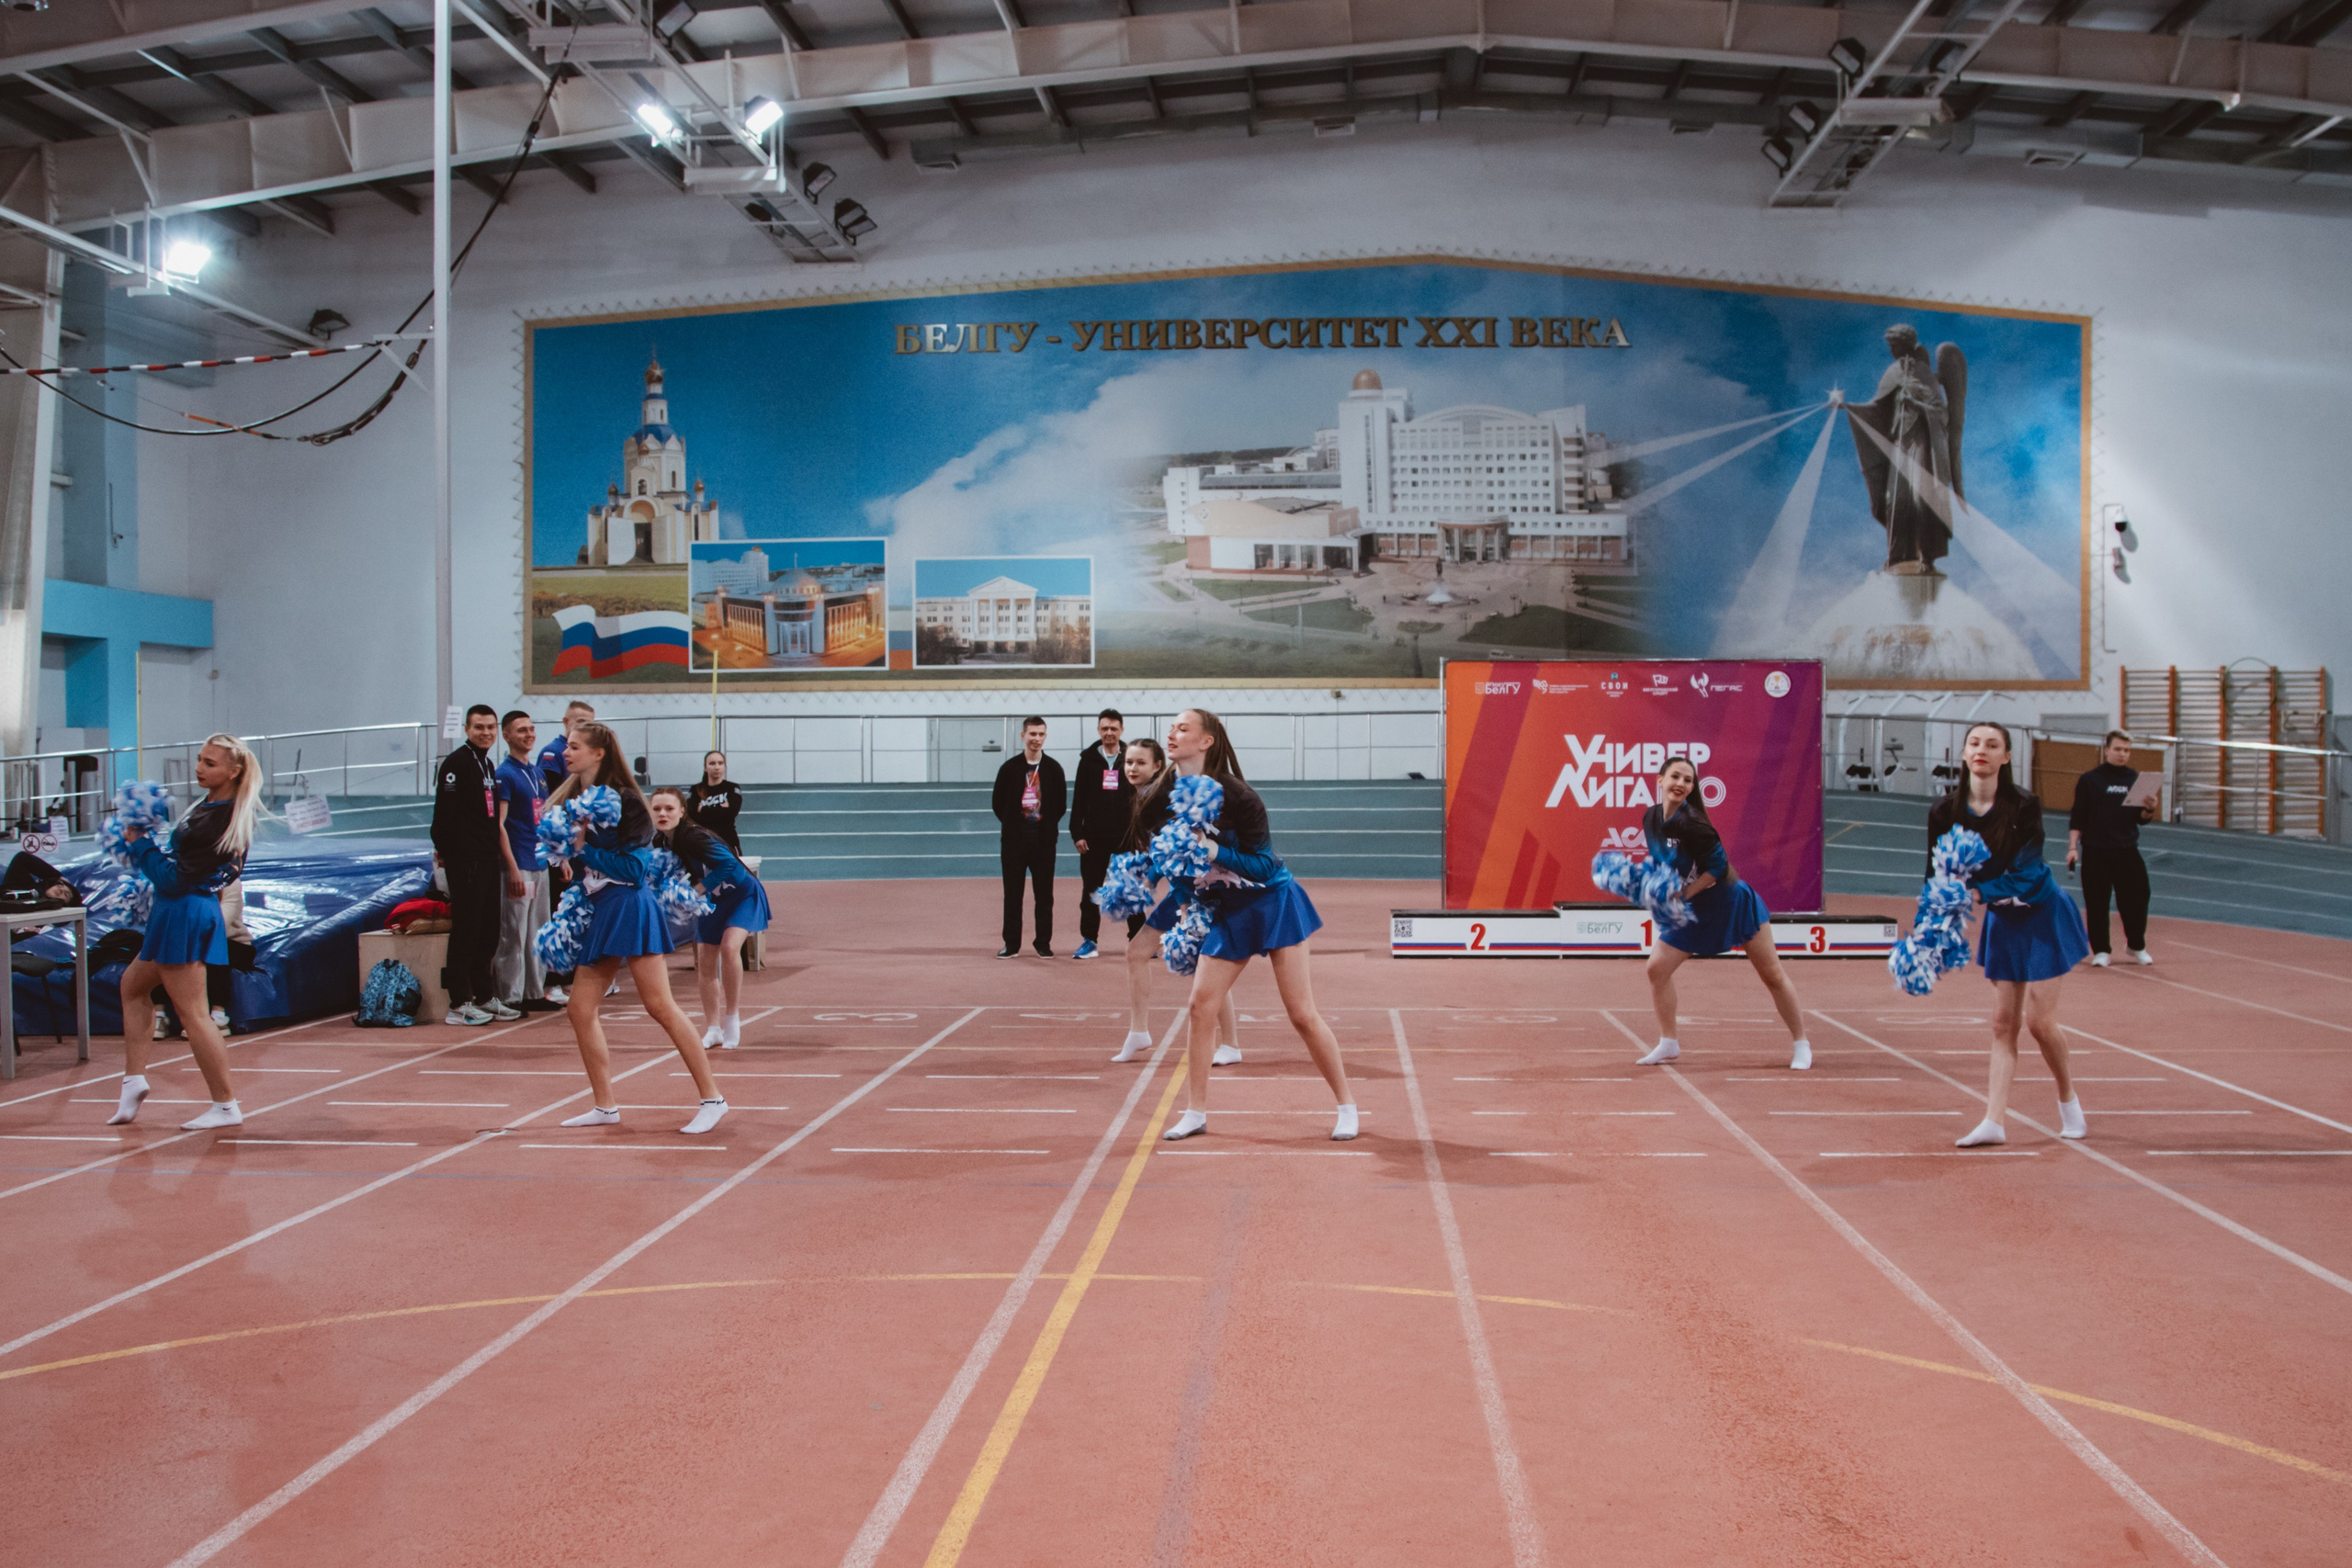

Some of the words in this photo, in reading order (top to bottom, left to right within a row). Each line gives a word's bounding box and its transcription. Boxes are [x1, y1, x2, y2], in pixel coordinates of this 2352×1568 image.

[894, 321, 1038, 355] БЕЛГУ
[1069, 318, 1408, 354] УНИВЕРСИТЕТ
[1415, 317, 1500, 348] XXI
[1509, 317, 1634, 348] ВЕКА
[1485, 682, 1521, 694] БелГУ
[1601, 682, 1628, 690] СВОИ
[1470, 922, 1487, 951] 2
[1587, 921, 1623, 934] БелГУ
[1640, 919, 1653, 947] 1
[1810, 926, 1826, 953] 3
